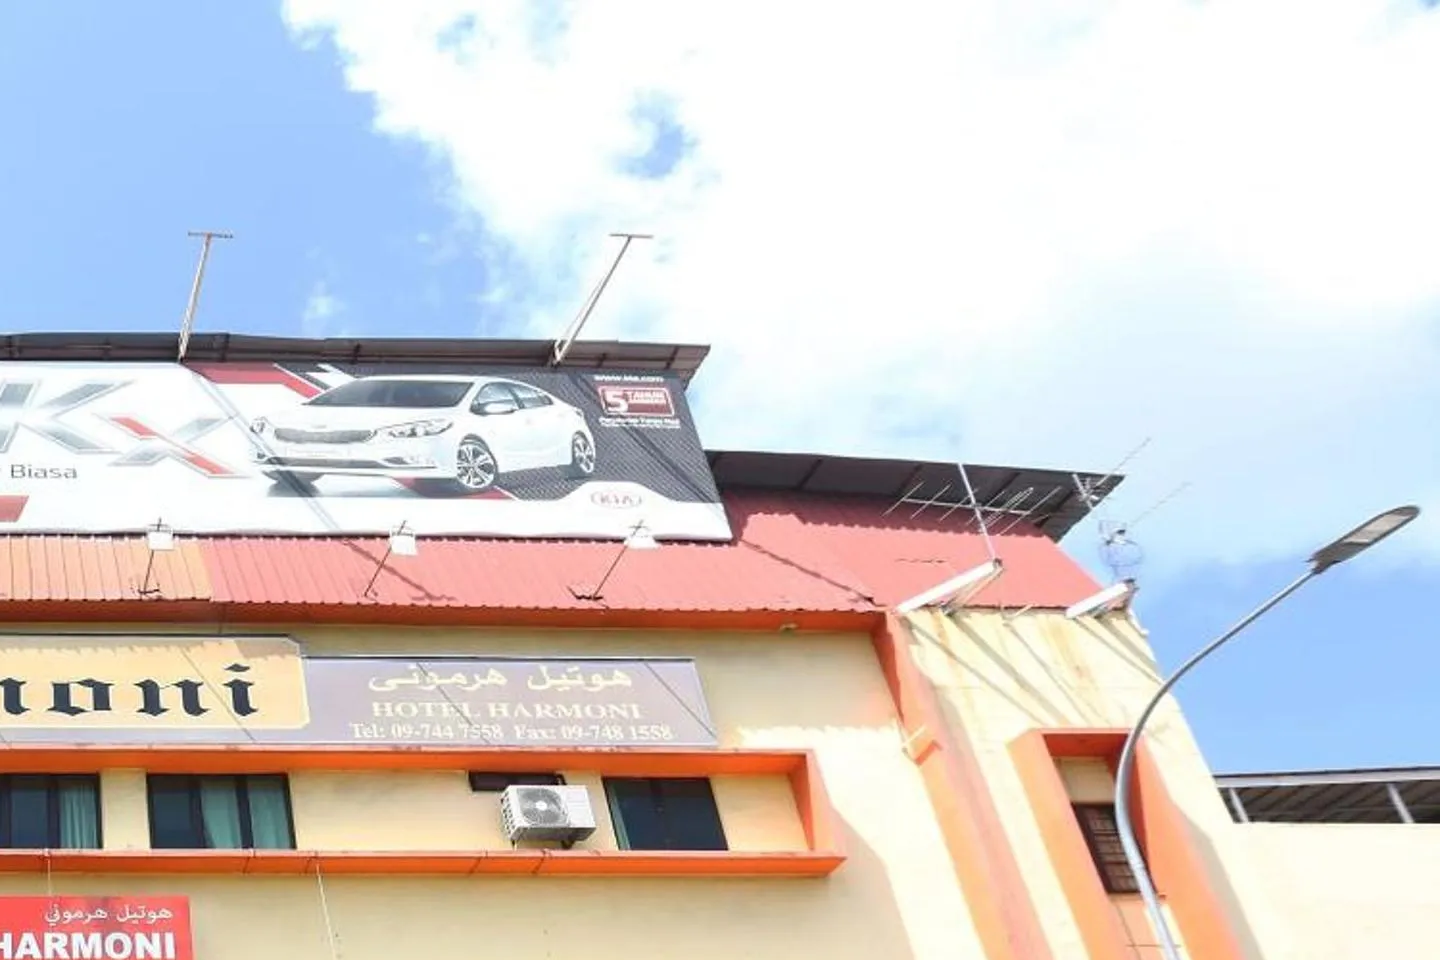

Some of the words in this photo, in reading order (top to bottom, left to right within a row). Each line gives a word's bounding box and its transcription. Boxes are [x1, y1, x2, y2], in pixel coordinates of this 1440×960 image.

[603, 389, 629, 412] 5
[9, 463, 79, 479] Biasa
[371, 701, 481, 718] HOTEL
[488, 701, 643, 719] HARMONI
[350, 722, 387, 739] Tel:
[390, 722, 454, 739] 09-744
[458, 723, 505, 739] 7558
[514, 723, 557, 740] Fax:
[630, 724, 674, 740] 1558
[116, 904, 173, 925] هوتيل
